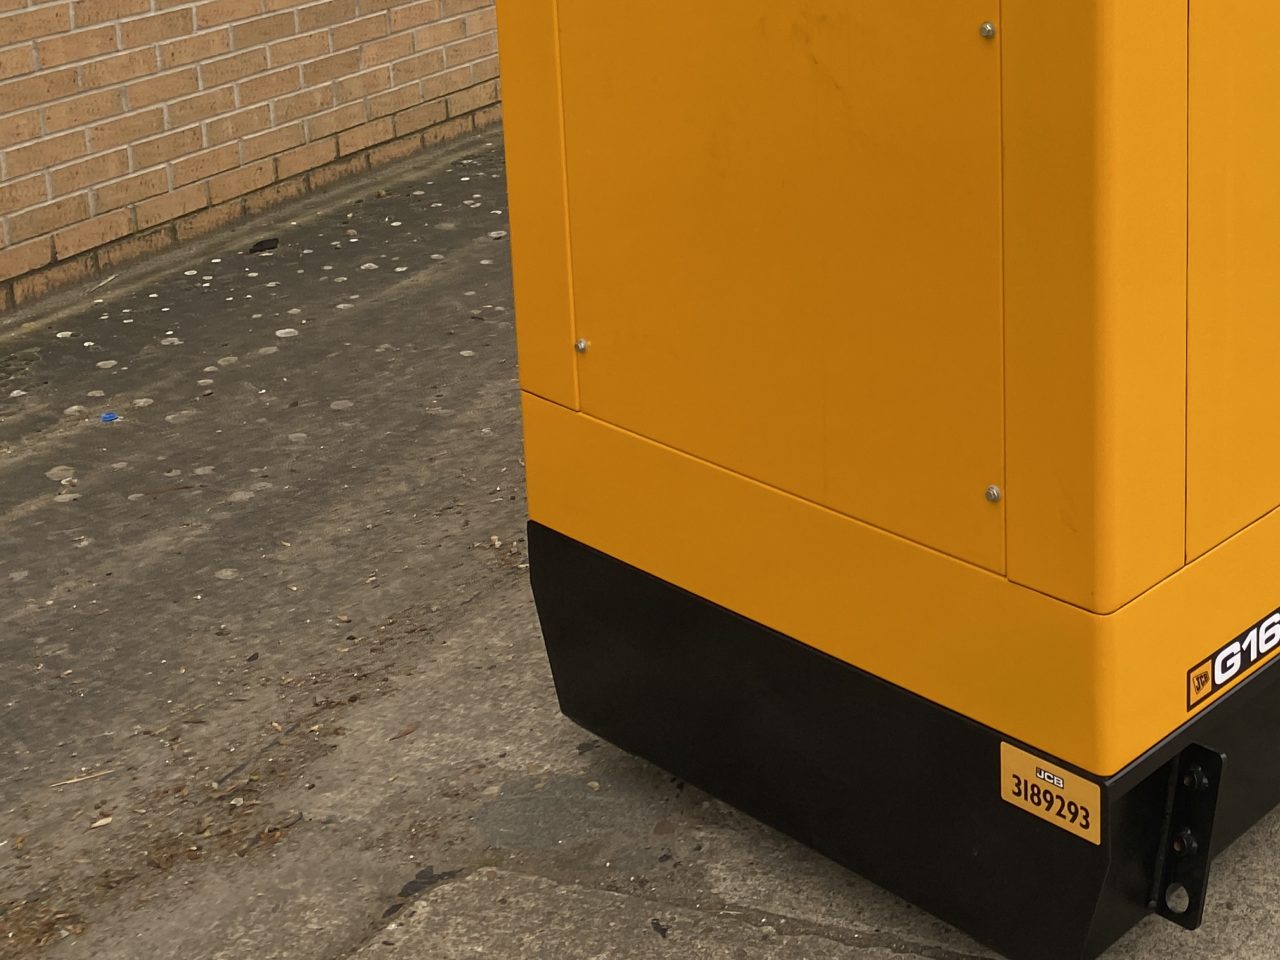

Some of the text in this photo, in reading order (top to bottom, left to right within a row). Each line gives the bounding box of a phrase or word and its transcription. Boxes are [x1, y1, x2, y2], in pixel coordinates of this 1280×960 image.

[1195, 673, 1209, 692] JCB
[1036, 768, 1064, 789] JCB
[1012, 774, 1090, 830] 3189293
